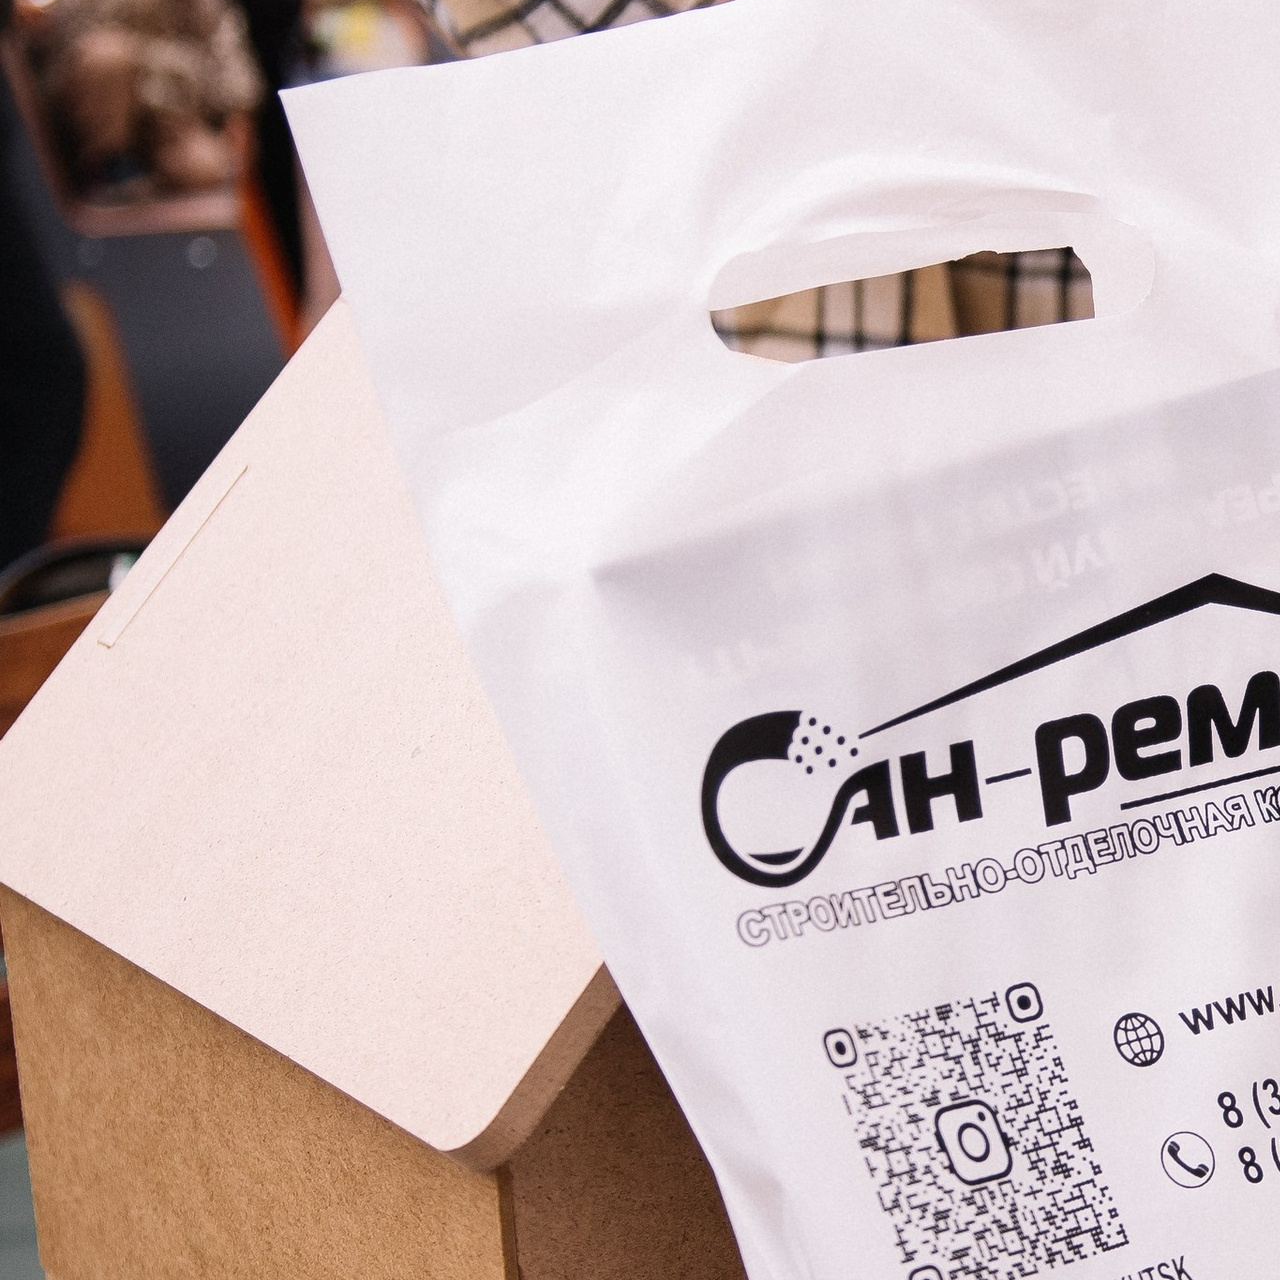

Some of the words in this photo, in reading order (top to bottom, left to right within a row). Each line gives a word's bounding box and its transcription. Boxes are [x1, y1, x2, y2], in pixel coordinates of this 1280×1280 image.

[737, 793, 1256, 948] СТРОИТЕЛЬНО-ОТДЕЛОЧНАЯ
[1216, 1090, 1244, 1129] 8
[1237, 1145, 1264, 1184] 8
